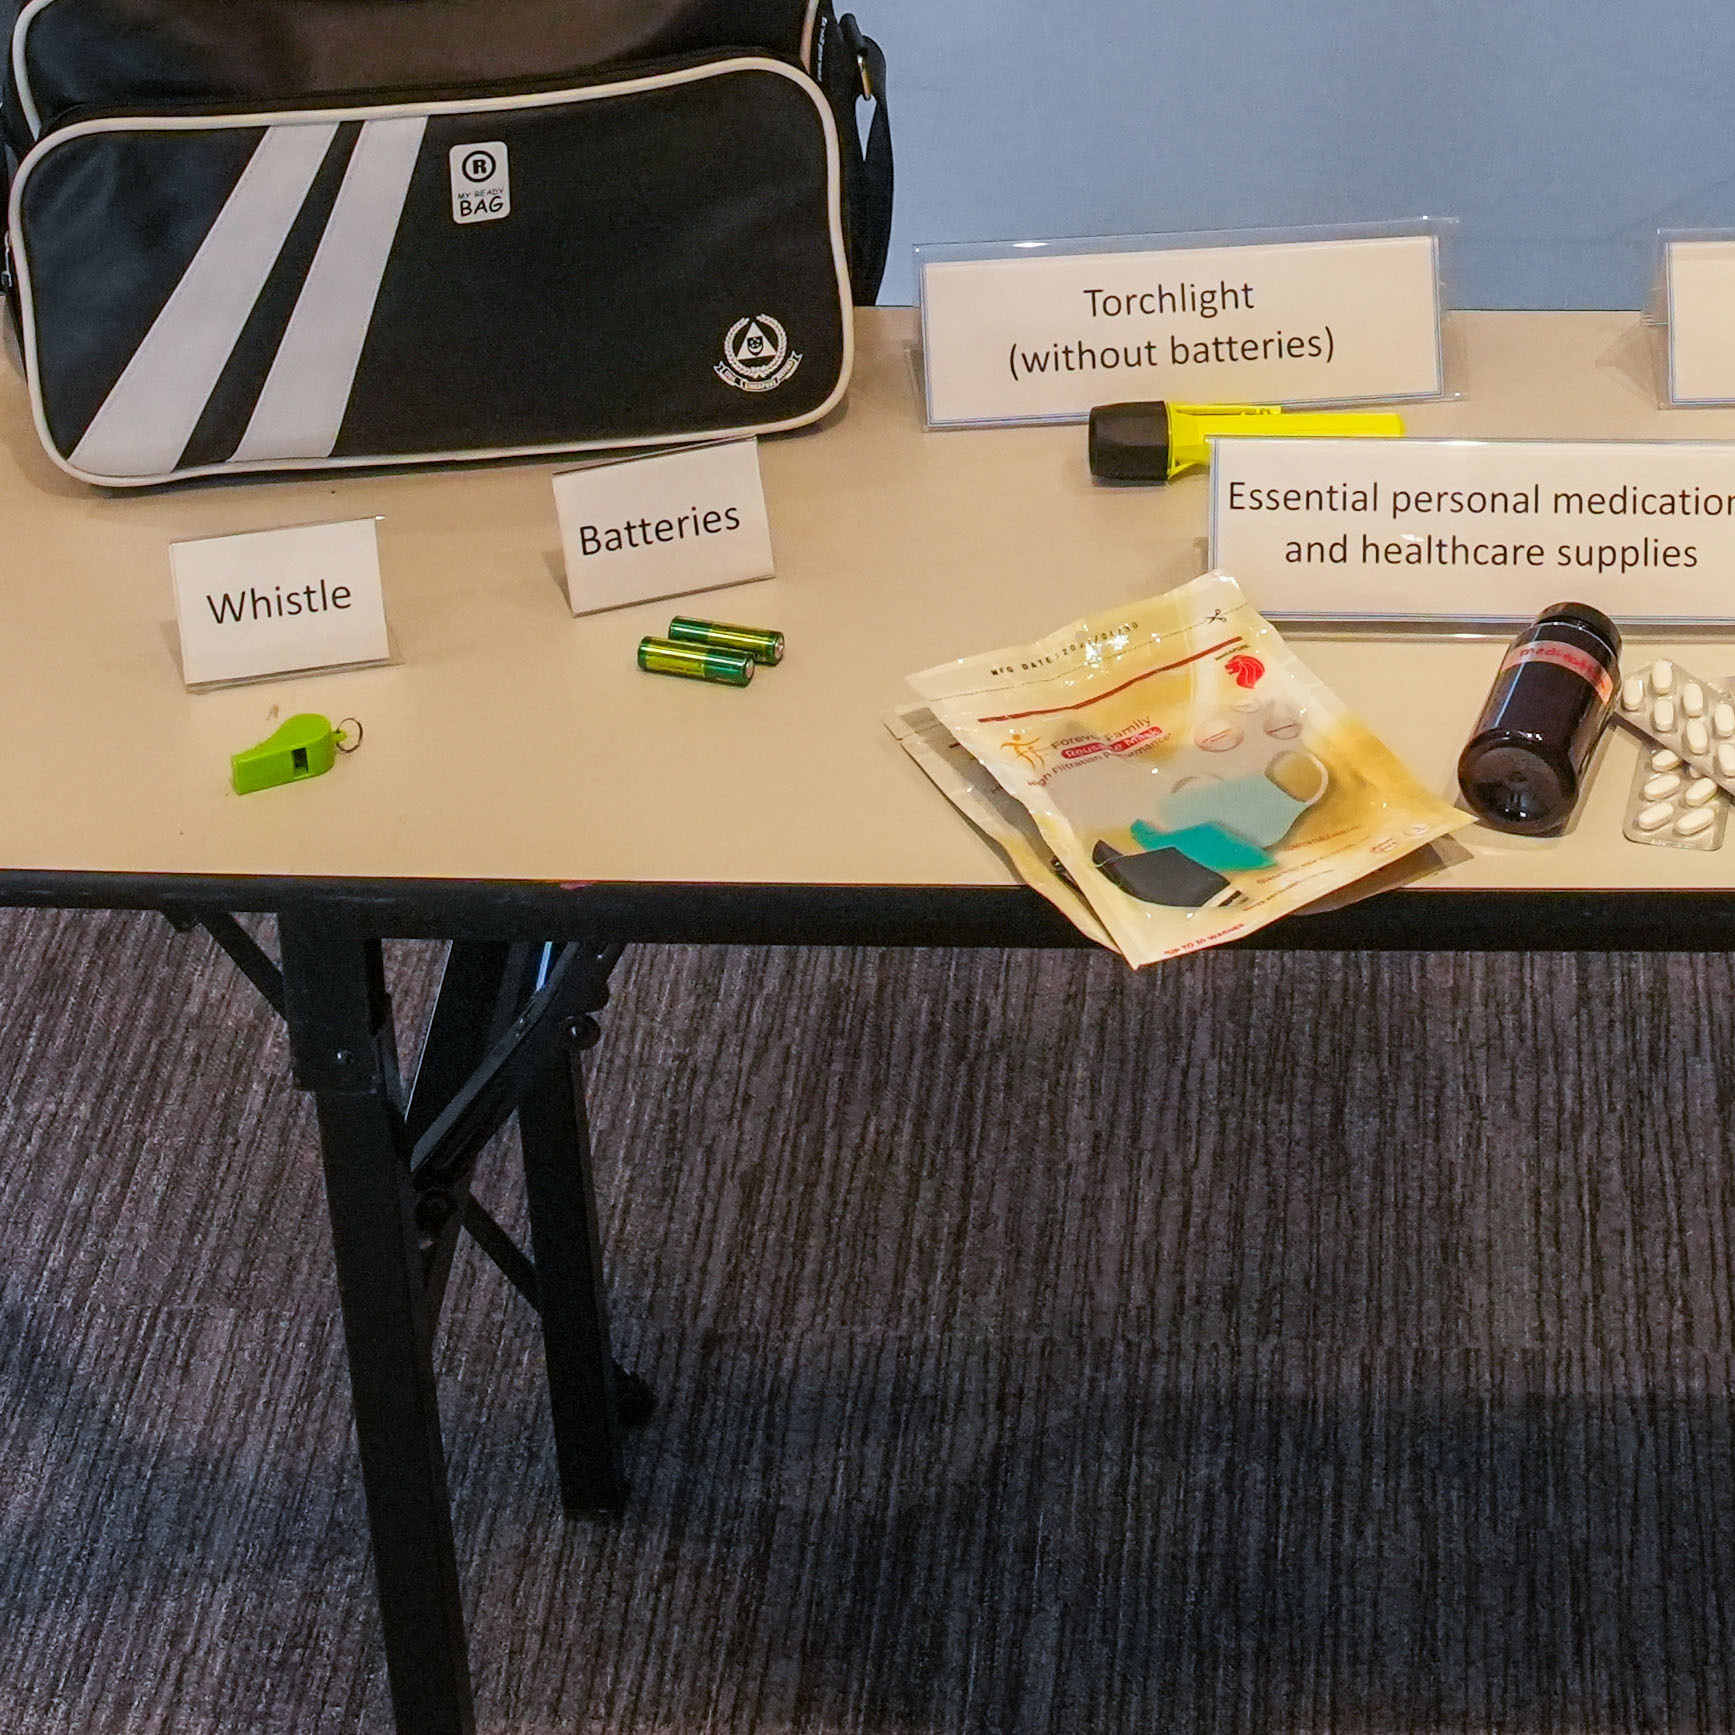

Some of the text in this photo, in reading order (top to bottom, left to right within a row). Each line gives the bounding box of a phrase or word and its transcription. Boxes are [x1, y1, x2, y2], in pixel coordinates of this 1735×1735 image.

[457, 187, 504, 200] MY READY
[460, 195, 504, 217] BAG
[1082, 280, 1255, 319] Torchlight
[1009, 325, 1334, 382] (without batteries)
[1229, 481, 1378, 512] Essential
[1392, 483, 1539, 520] personal
[579, 506, 740, 556] Batteries
[1285, 533, 1698, 574] and healthcare supplies
[206, 578, 352, 625] Whistle
[990, 664, 1014, 677] MFG
[1104, 716, 1152, 742] Family
